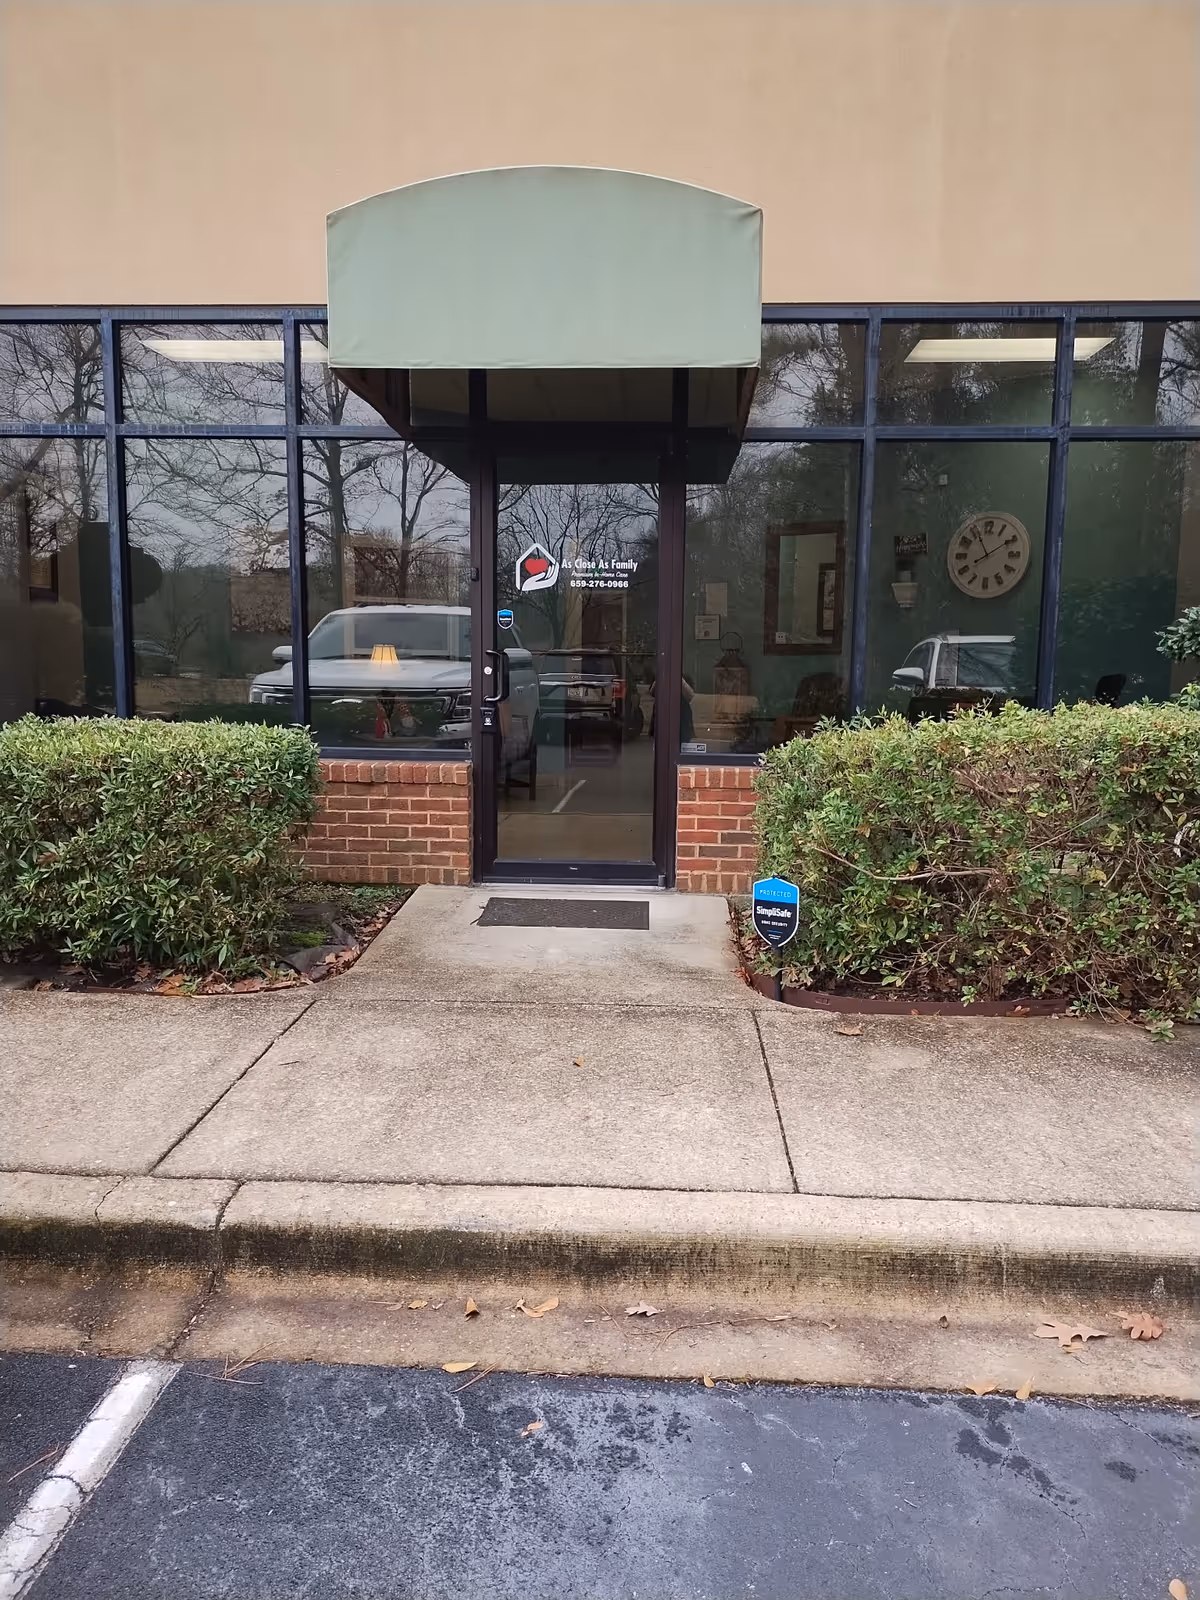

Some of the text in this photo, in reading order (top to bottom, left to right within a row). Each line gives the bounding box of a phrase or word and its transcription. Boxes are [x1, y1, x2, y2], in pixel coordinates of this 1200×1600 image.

[561, 559, 638, 572] As Close As Family
[570, 580, 629, 588] 659-276-0966
[756, 906, 792, 917] SimpliSafe
